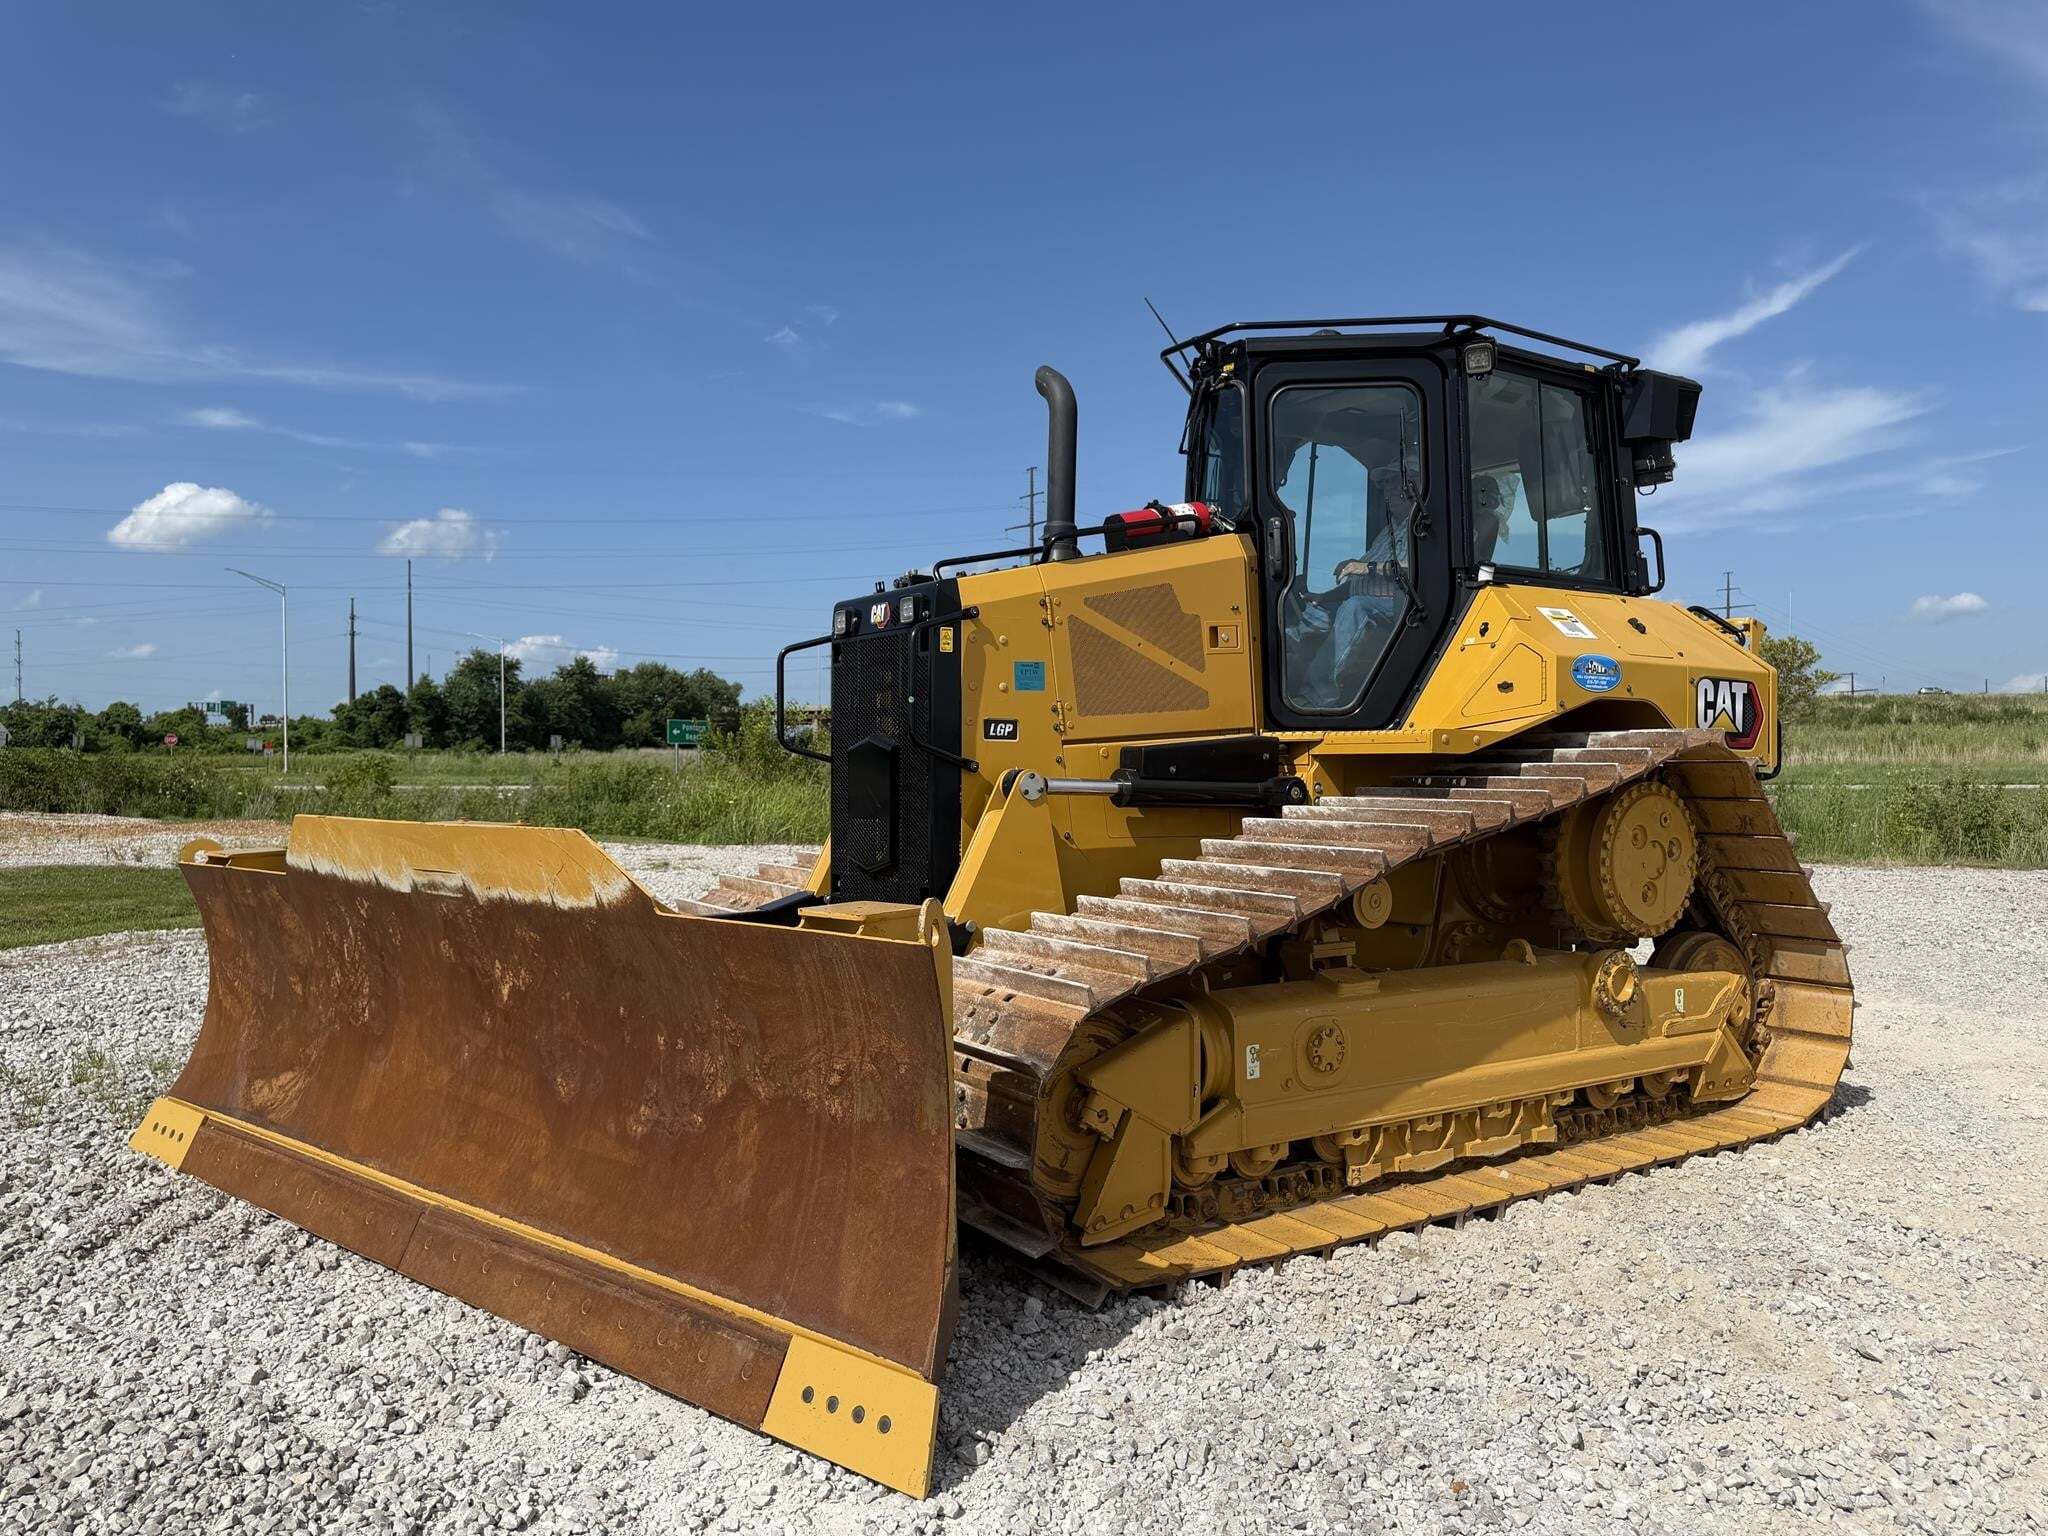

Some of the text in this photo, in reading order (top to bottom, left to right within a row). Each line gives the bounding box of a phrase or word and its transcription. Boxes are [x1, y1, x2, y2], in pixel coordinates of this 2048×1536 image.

[871, 602, 886, 623] CAT
[1697, 678, 1748, 733] CAT
[989, 723, 1014, 737] LGP
